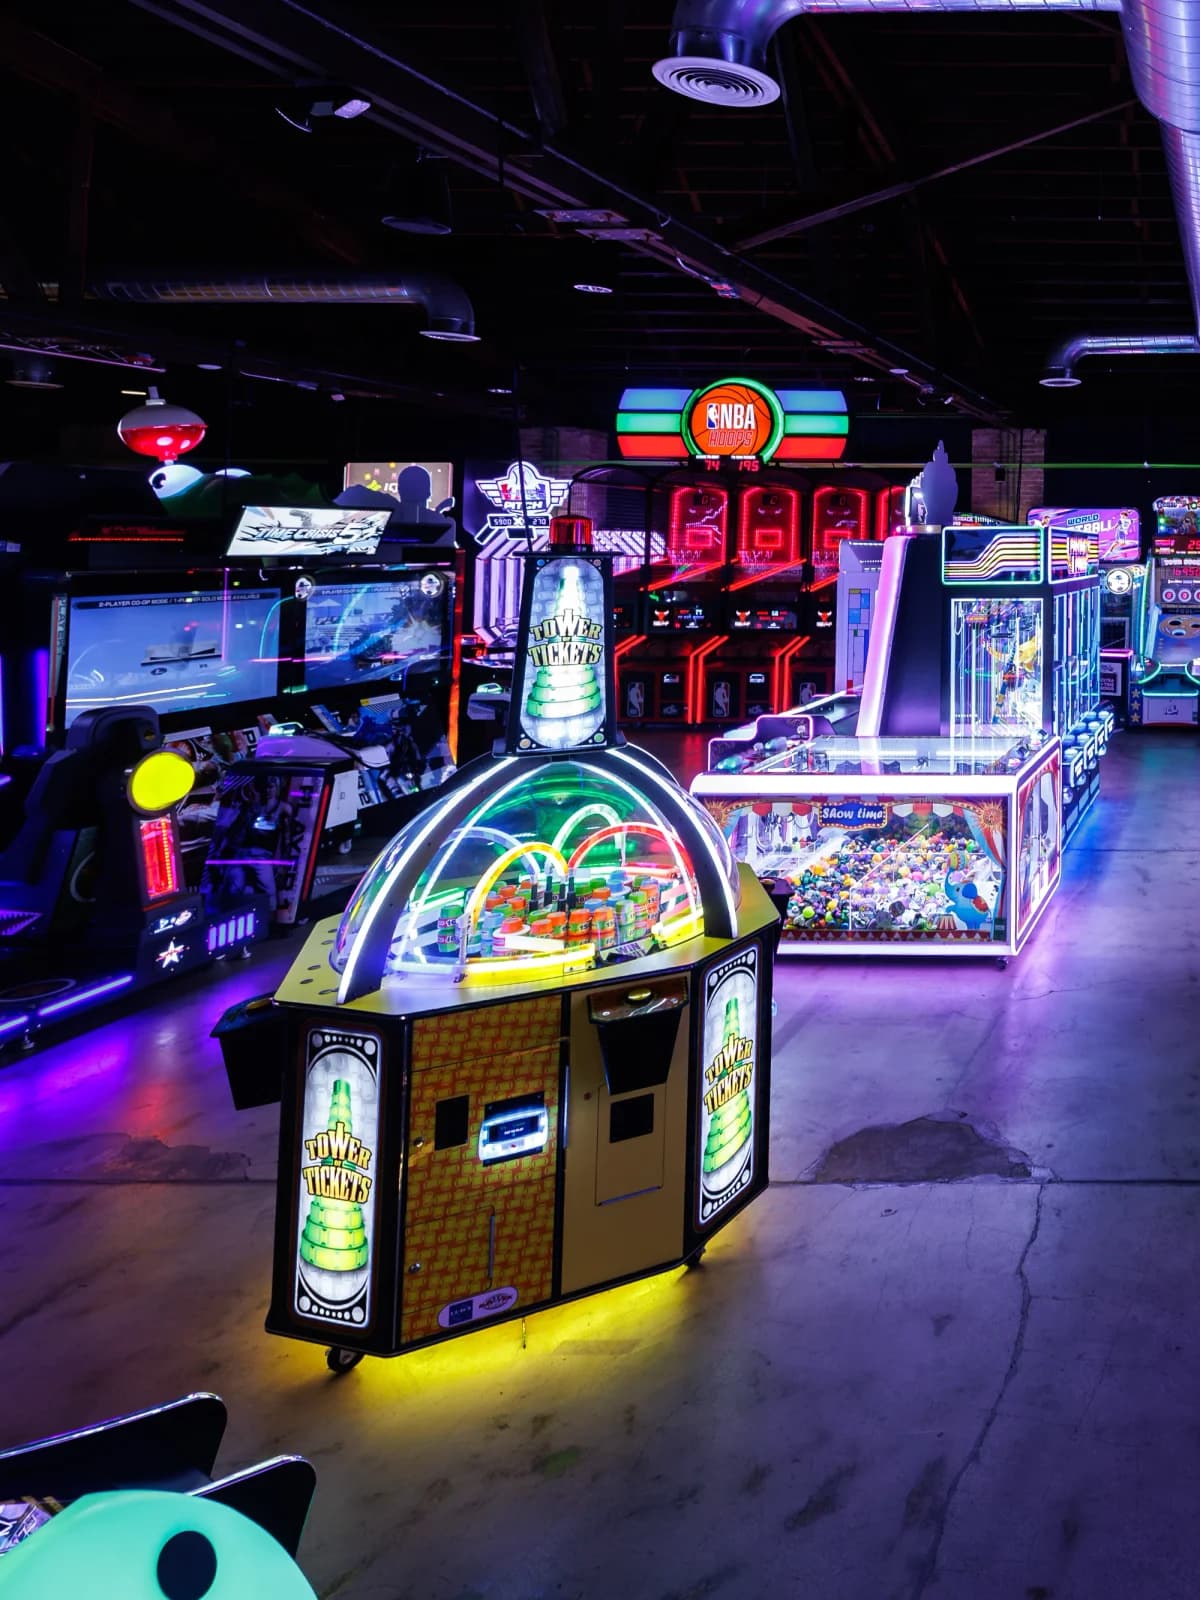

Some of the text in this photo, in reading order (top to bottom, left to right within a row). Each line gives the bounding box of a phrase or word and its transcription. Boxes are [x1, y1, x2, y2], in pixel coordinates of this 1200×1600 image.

[719, 403, 756, 430] NBA
[708, 430, 753, 447] HOOPS
[704, 460, 720, 471] 74
[738, 460, 760, 472] 195
[1066, 513, 1100, 527] WORLD
[254, 527, 294, 541] TIME
[293, 527, 340, 541] CRISIS
[530, 608, 604, 641] TOWER
[527, 641, 604, 667] TICKETS
[704, 1032, 754, 1086] TOWER
[703, 1061, 754, 1116] TICKETS
[304, 1121, 373, 1170] TOWER
[302, 1165, 373, 1205] TICKETS
